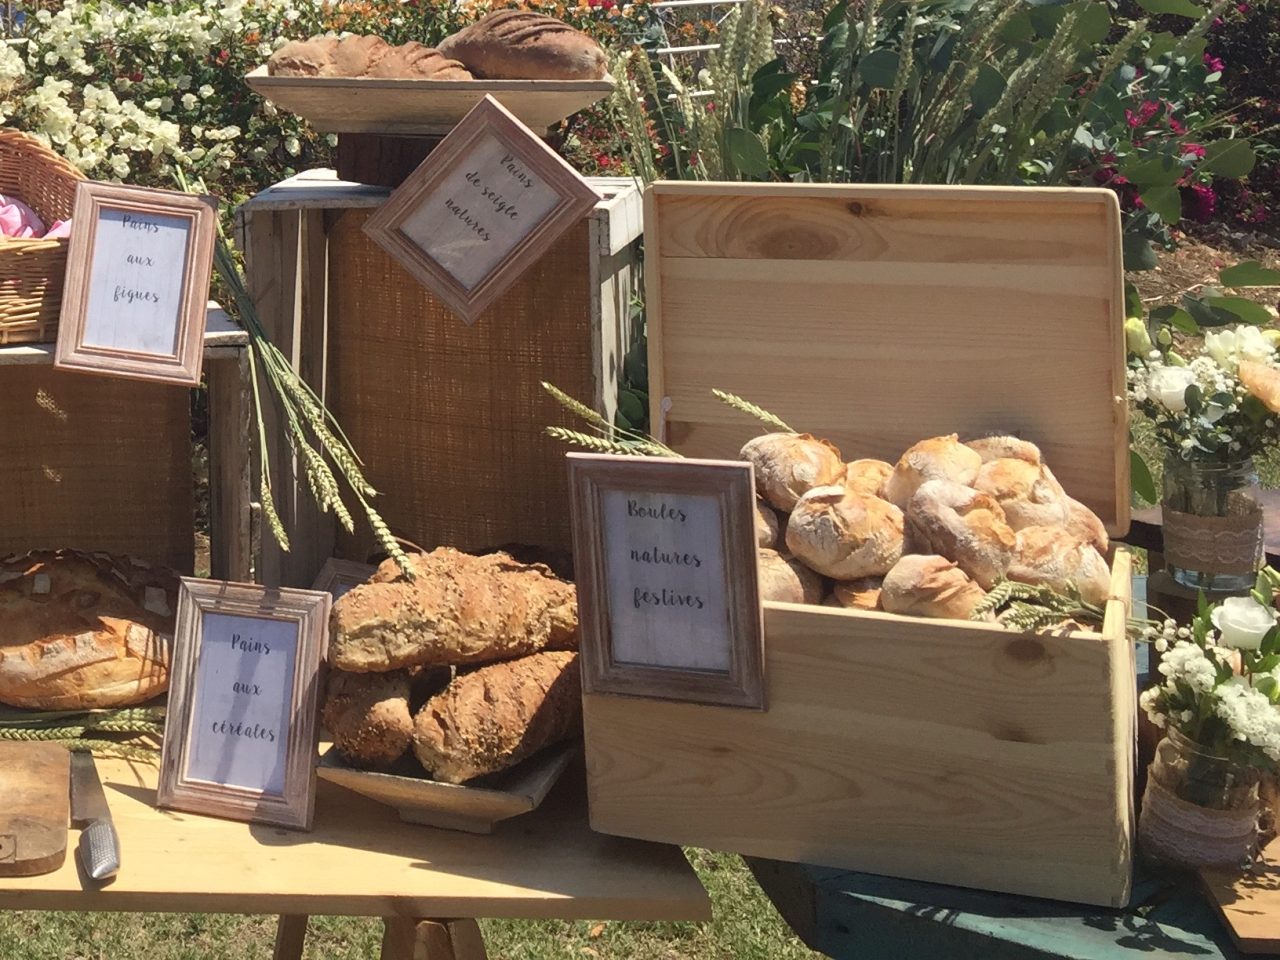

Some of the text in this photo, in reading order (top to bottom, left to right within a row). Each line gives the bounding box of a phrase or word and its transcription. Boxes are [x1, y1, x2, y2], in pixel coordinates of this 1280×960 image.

[465, 171, 481, 187] de
[499, 154, 533, 189] Pains
[122, 213, 160, 233] Pains
[445, 198, 491, 242] natures
[126, 253, 155, 267] aux
[113, 285, 161, 304] figues
[627, 498, 687, 523] Boules
[630, 546, 702, 568] natures
[633, 587, 704, 609] festives
[231, 633, 271, 655] Pains
[232, 683, 262, 696] aux
[212, 720, 276, 742] céréales
